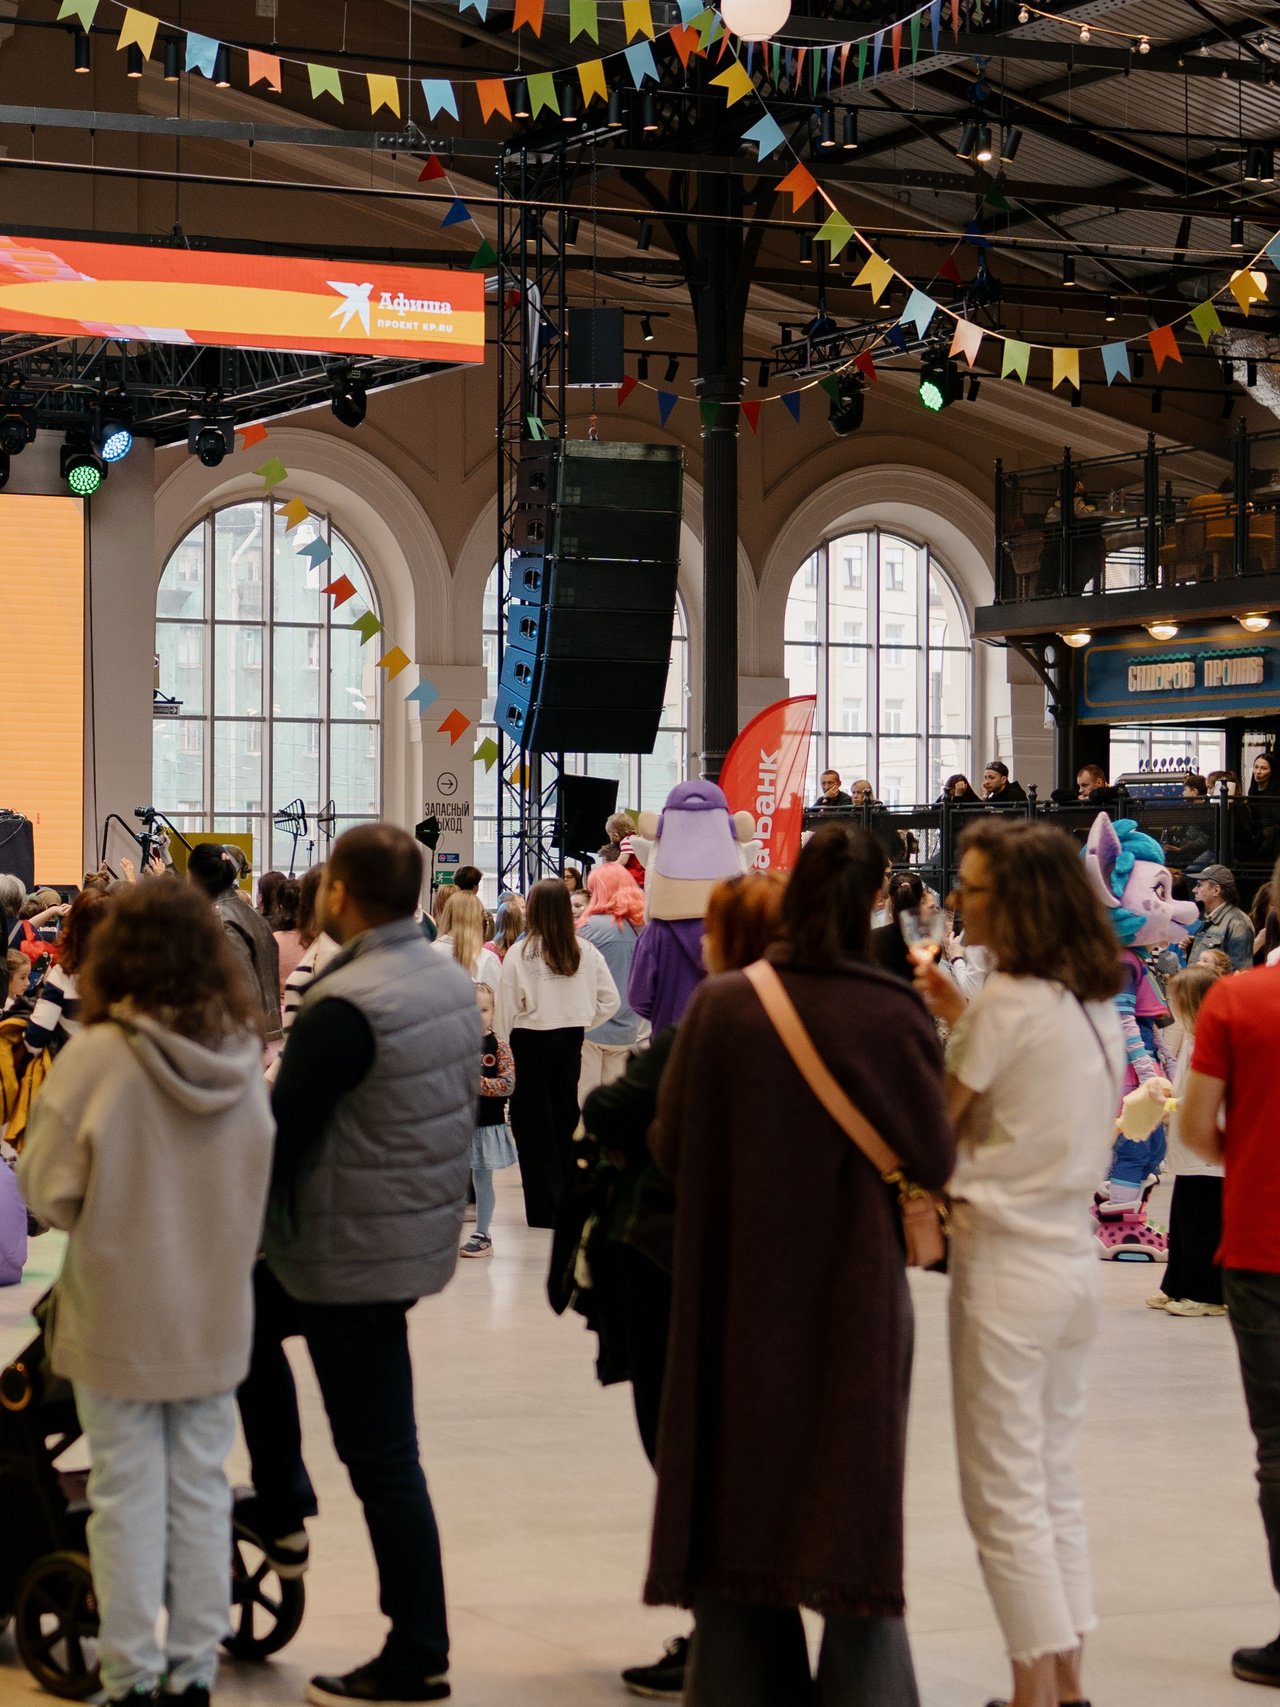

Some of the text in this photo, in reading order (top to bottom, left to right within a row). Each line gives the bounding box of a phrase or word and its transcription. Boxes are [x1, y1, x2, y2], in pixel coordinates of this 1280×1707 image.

[377, 292, 453, 316] Афиша
[377, 319, 453, 333] ПРОЕКТ KP.RU
[1203, 656, 1264, 688] ПРОЛИВ
[425, 801, 470, 817] ЗАПАСНЫЙ
[437, 817, 463, 834] ЫХОД
